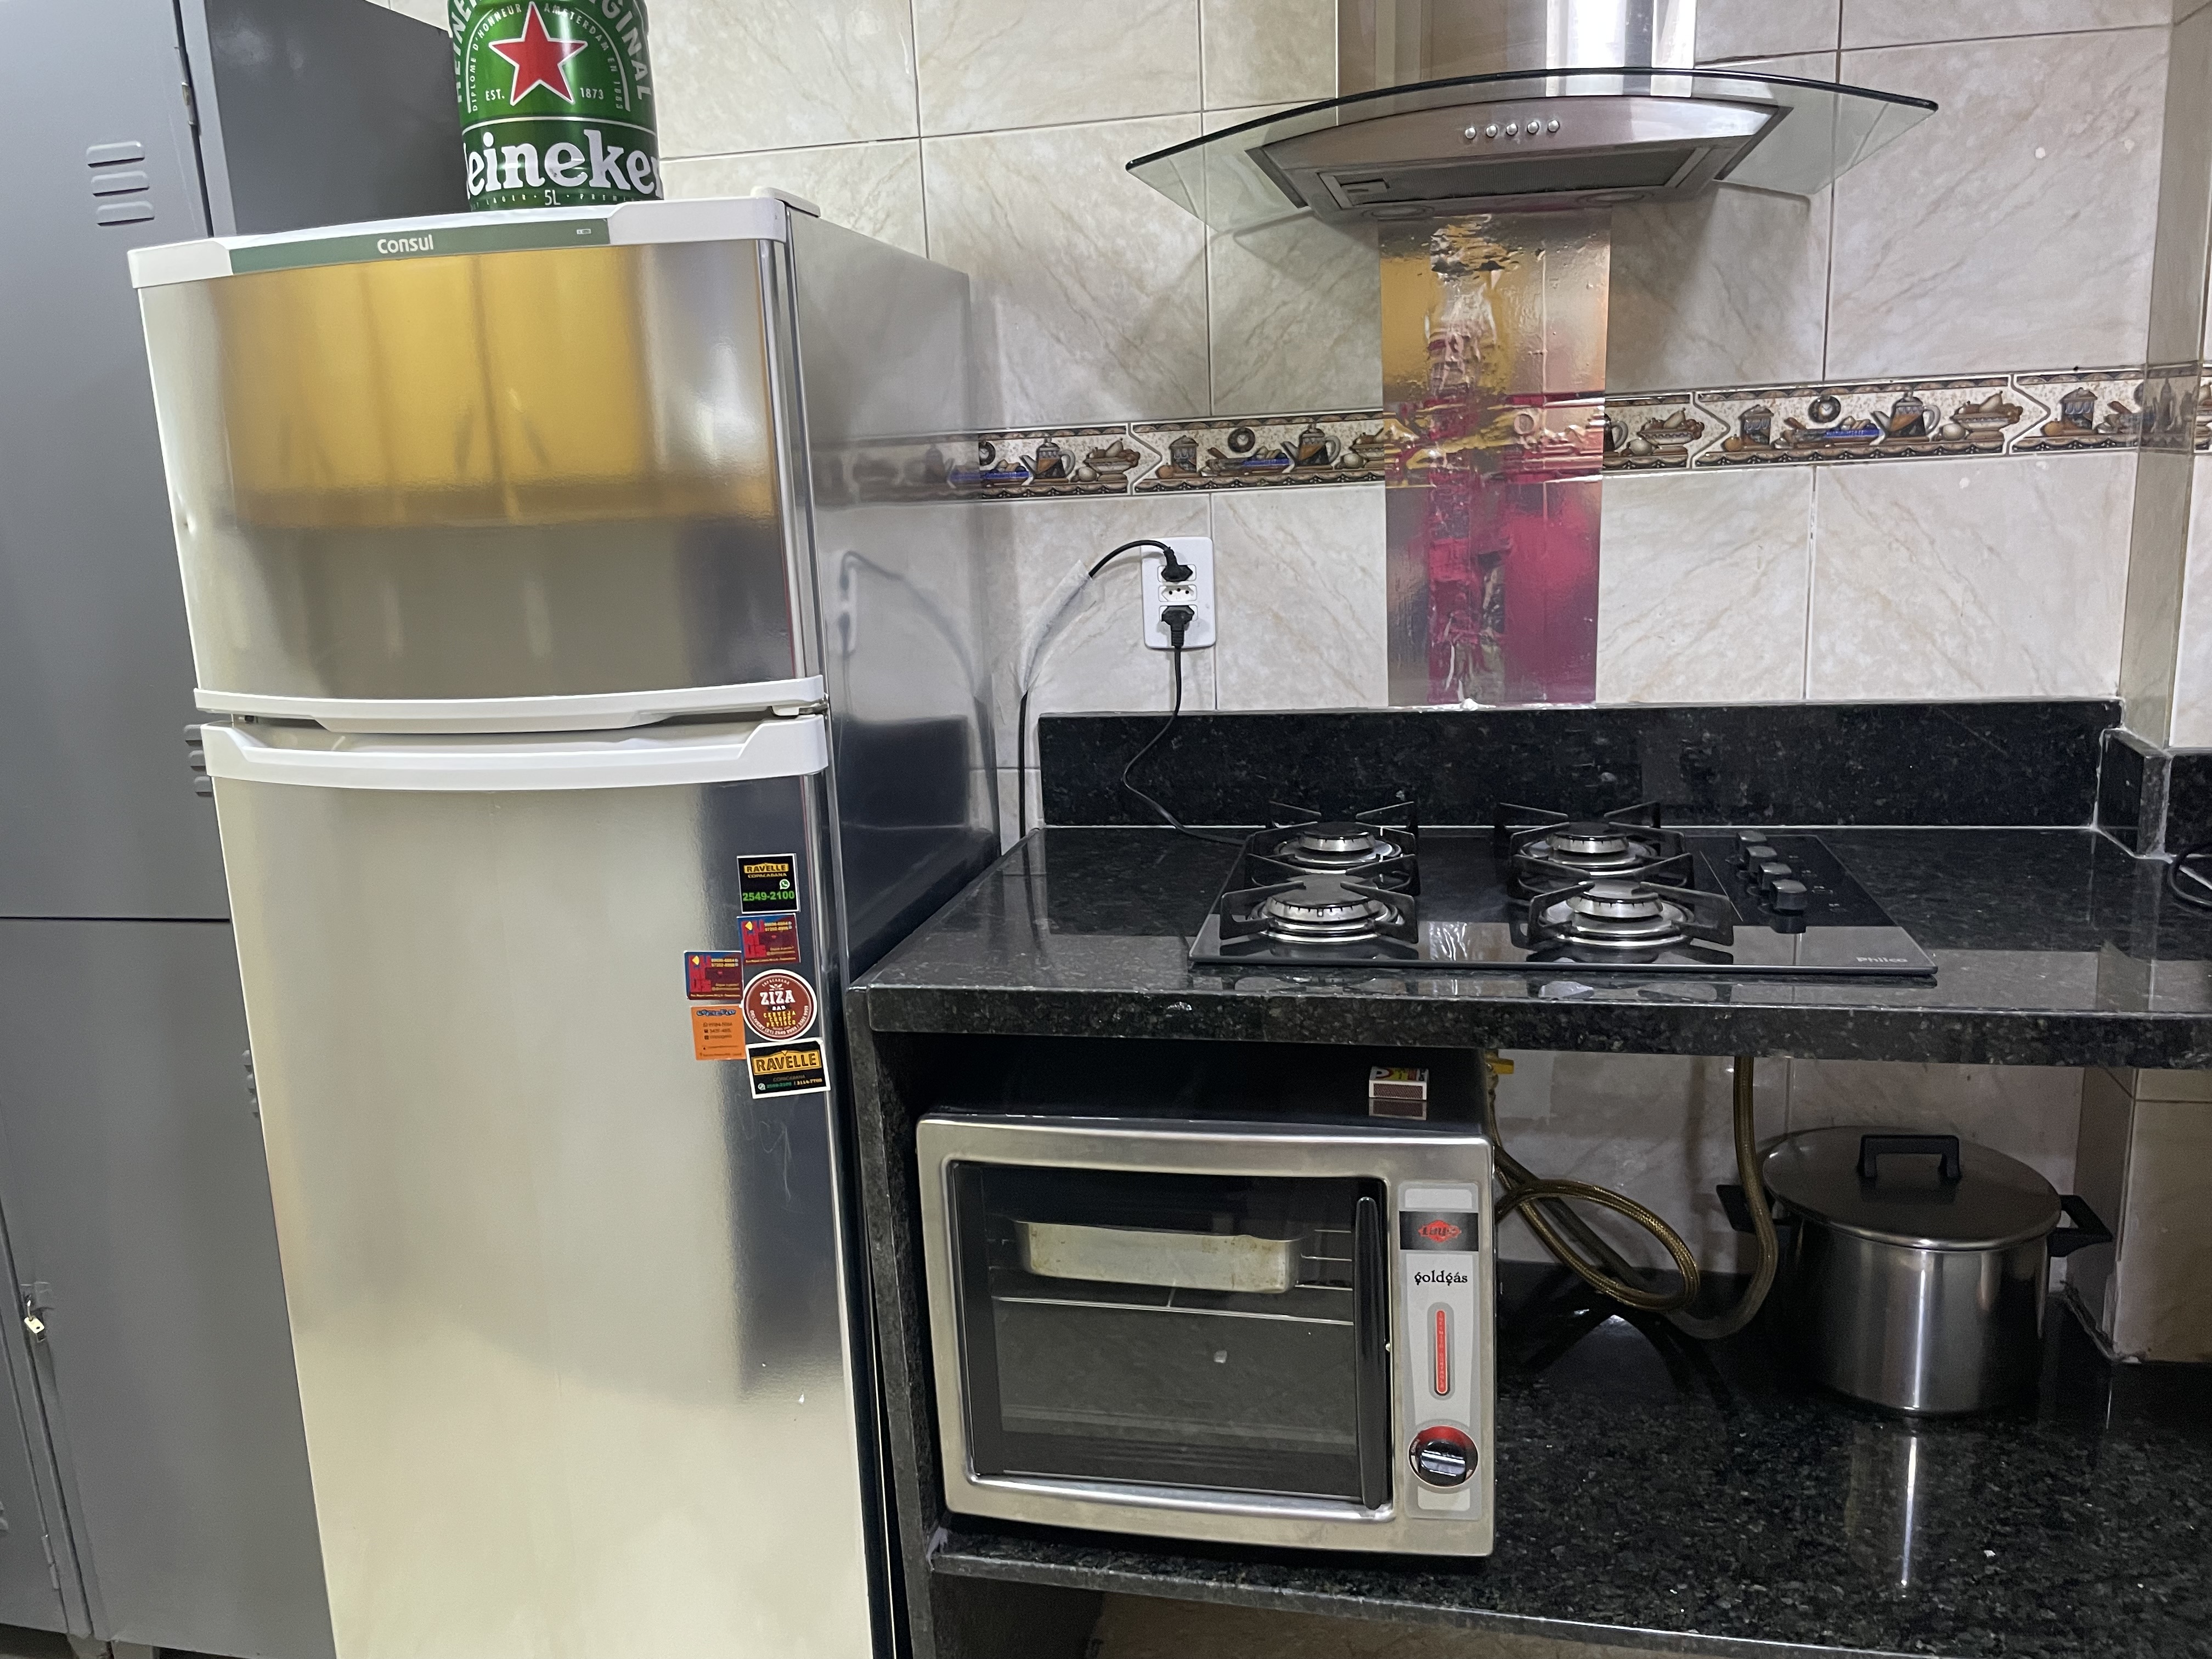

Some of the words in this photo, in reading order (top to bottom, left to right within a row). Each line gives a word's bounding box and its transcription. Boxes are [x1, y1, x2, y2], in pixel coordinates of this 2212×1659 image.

[472, 3, 522, 51] D'HONNEUR
[470, 58, 478, 111] DIPLOME
[486, 89, 505, 101] EST.
[580, 87, 604, 100] 1873
[464, 129, 663, 200] eineke
[544, 189, 561, 206] 5L
[377, 234, 434, 254] Consul
[742, 890, 795, 901] 2549-2100
[760, 990, 795, 1005] ZIZA
[756, 1053, 816, 1071] RAVELLE
[1414, 1269, 1468, 1286] goldgás
